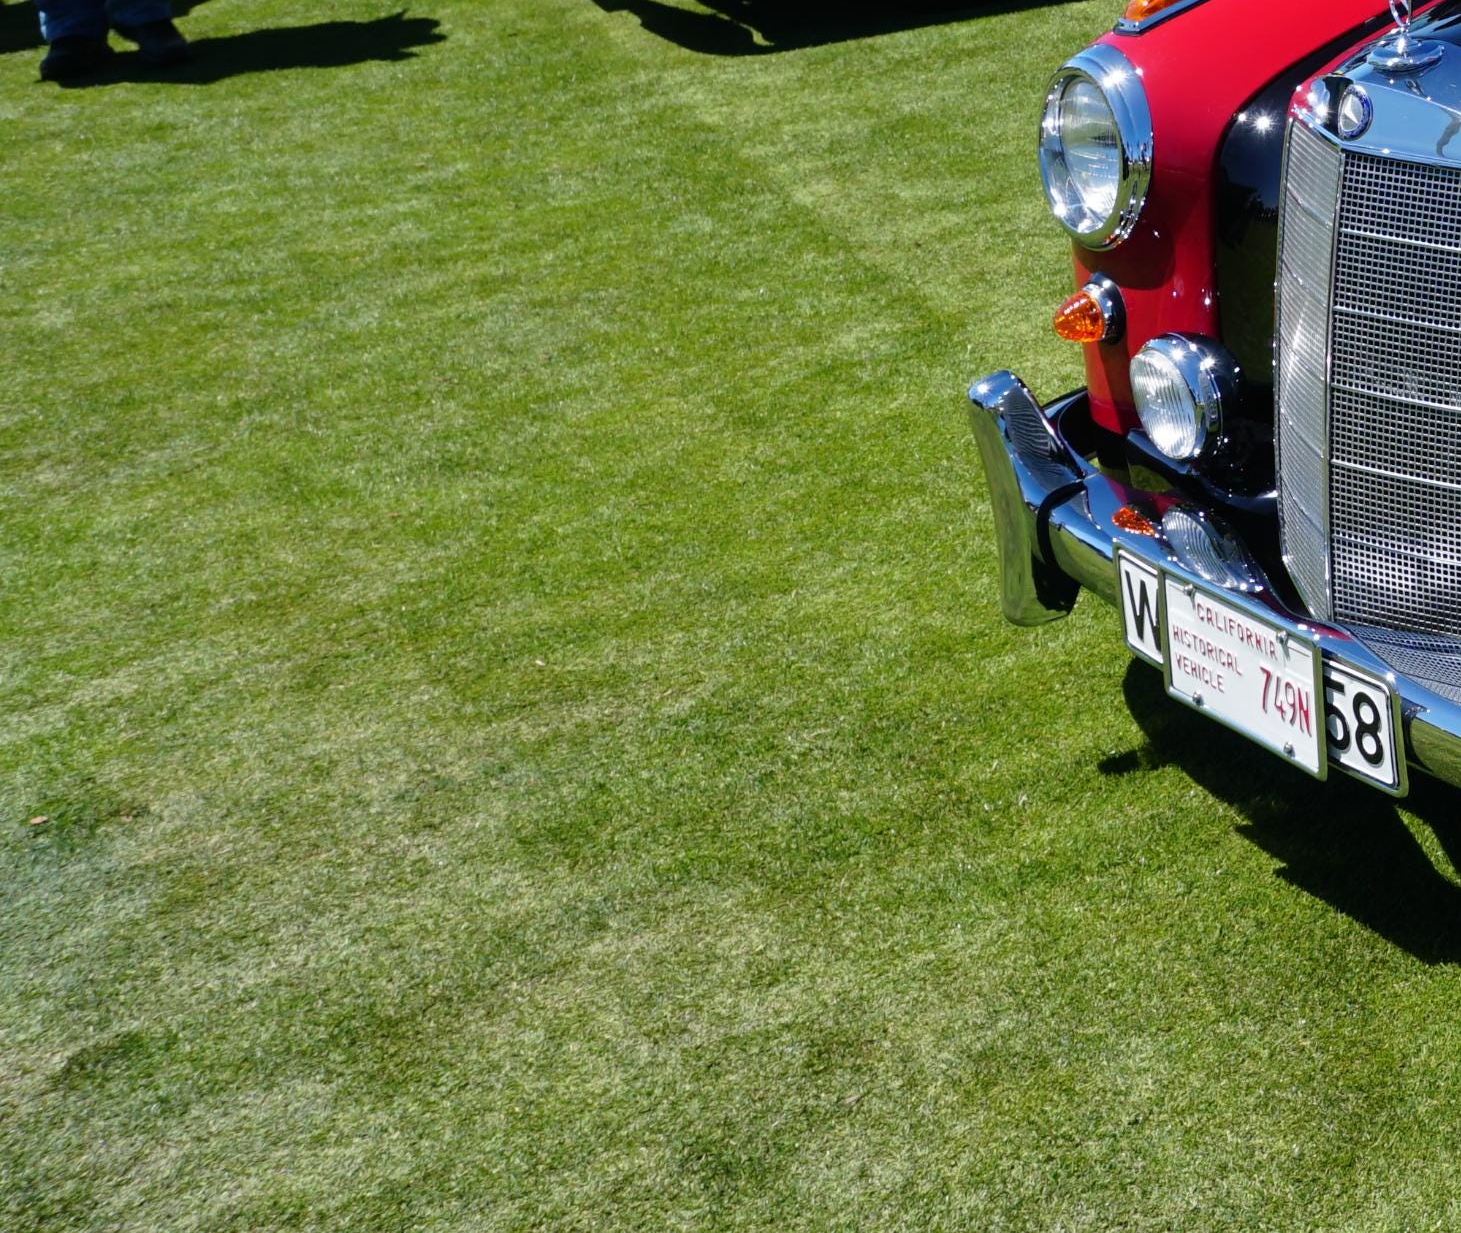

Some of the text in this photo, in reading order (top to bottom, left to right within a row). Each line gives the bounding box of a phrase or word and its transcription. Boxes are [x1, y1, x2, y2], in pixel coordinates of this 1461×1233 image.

[1172, 625, 1243, 676] HISTORICAL
[1196, 601, 1279, 660] CALIFORNIA
[1174, 653, 1226, 694] VEHICLE
[1260, 665, 1312, 738] 749N
[1327, 676, 1384, 765] 58
